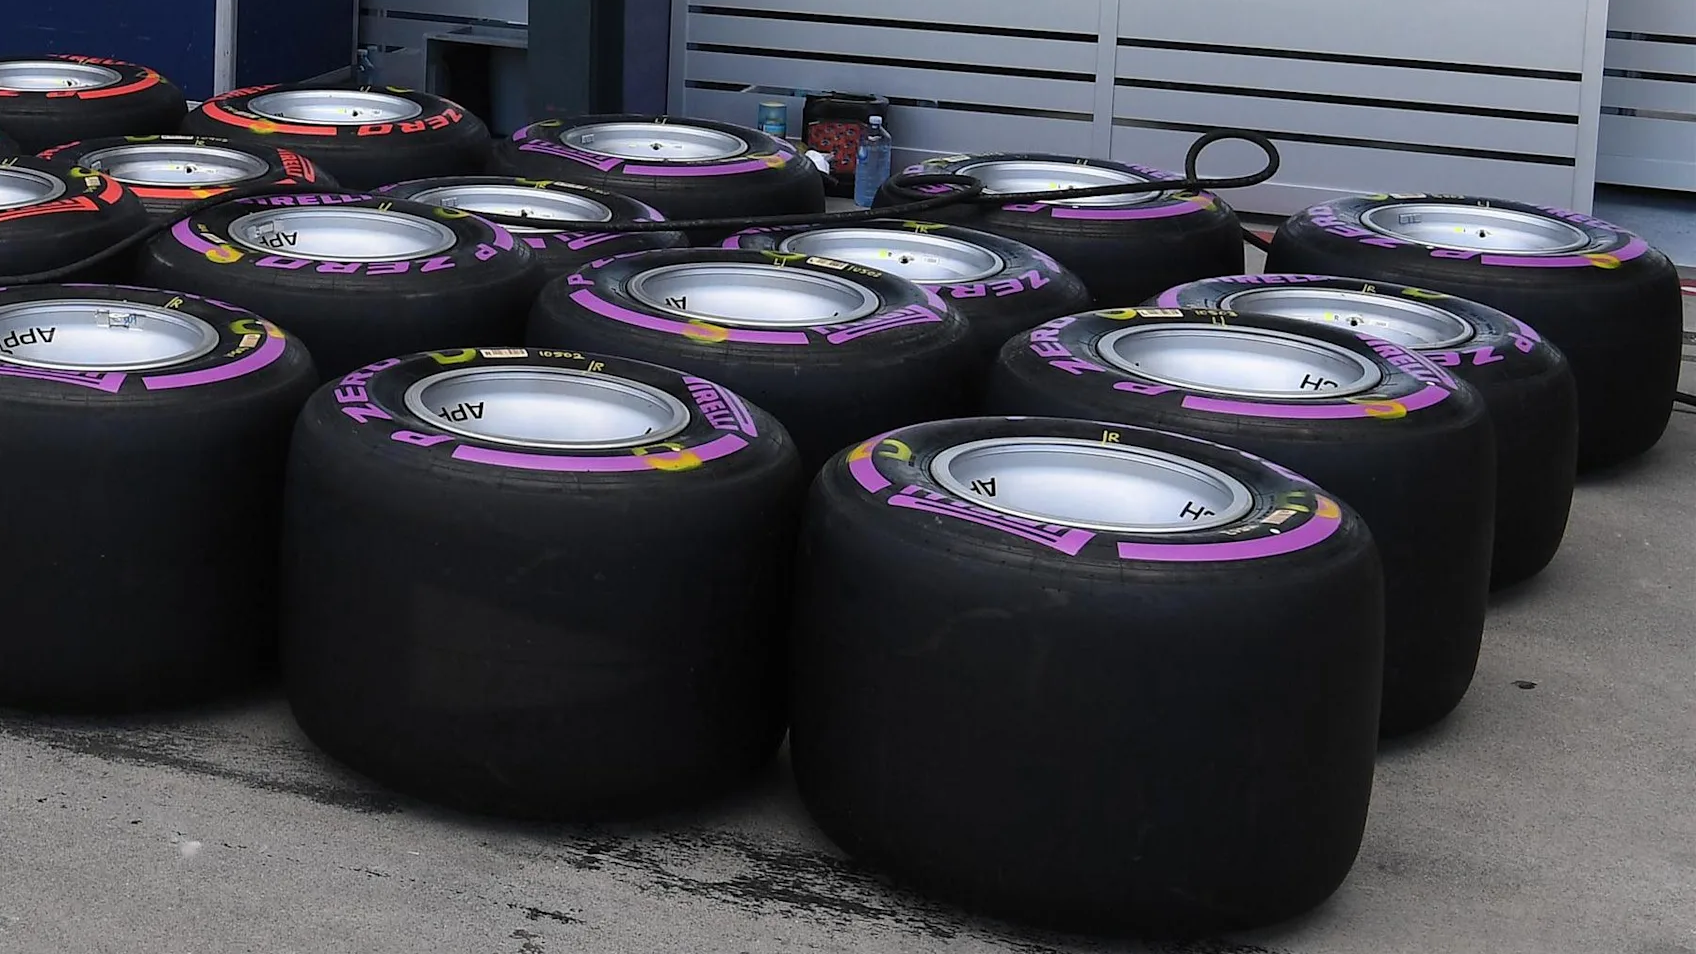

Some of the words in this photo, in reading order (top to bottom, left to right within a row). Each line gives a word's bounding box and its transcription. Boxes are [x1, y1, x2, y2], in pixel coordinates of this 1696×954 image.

[357, 111, 463, 137] ZERO
[276, 147, 317, 184] PIRELLI
[254, 255, 457, 276] ZERO
[538, 349, 586, 360] 10502
[1028, 316, 1110, 375] ZERO
[1352, 333, 1459, 391] PIRELLI
[331, 357, 402, 425] ZERO
[682, 375, 760, 438] PIRELLI
[389, 429, 456, 447] P
